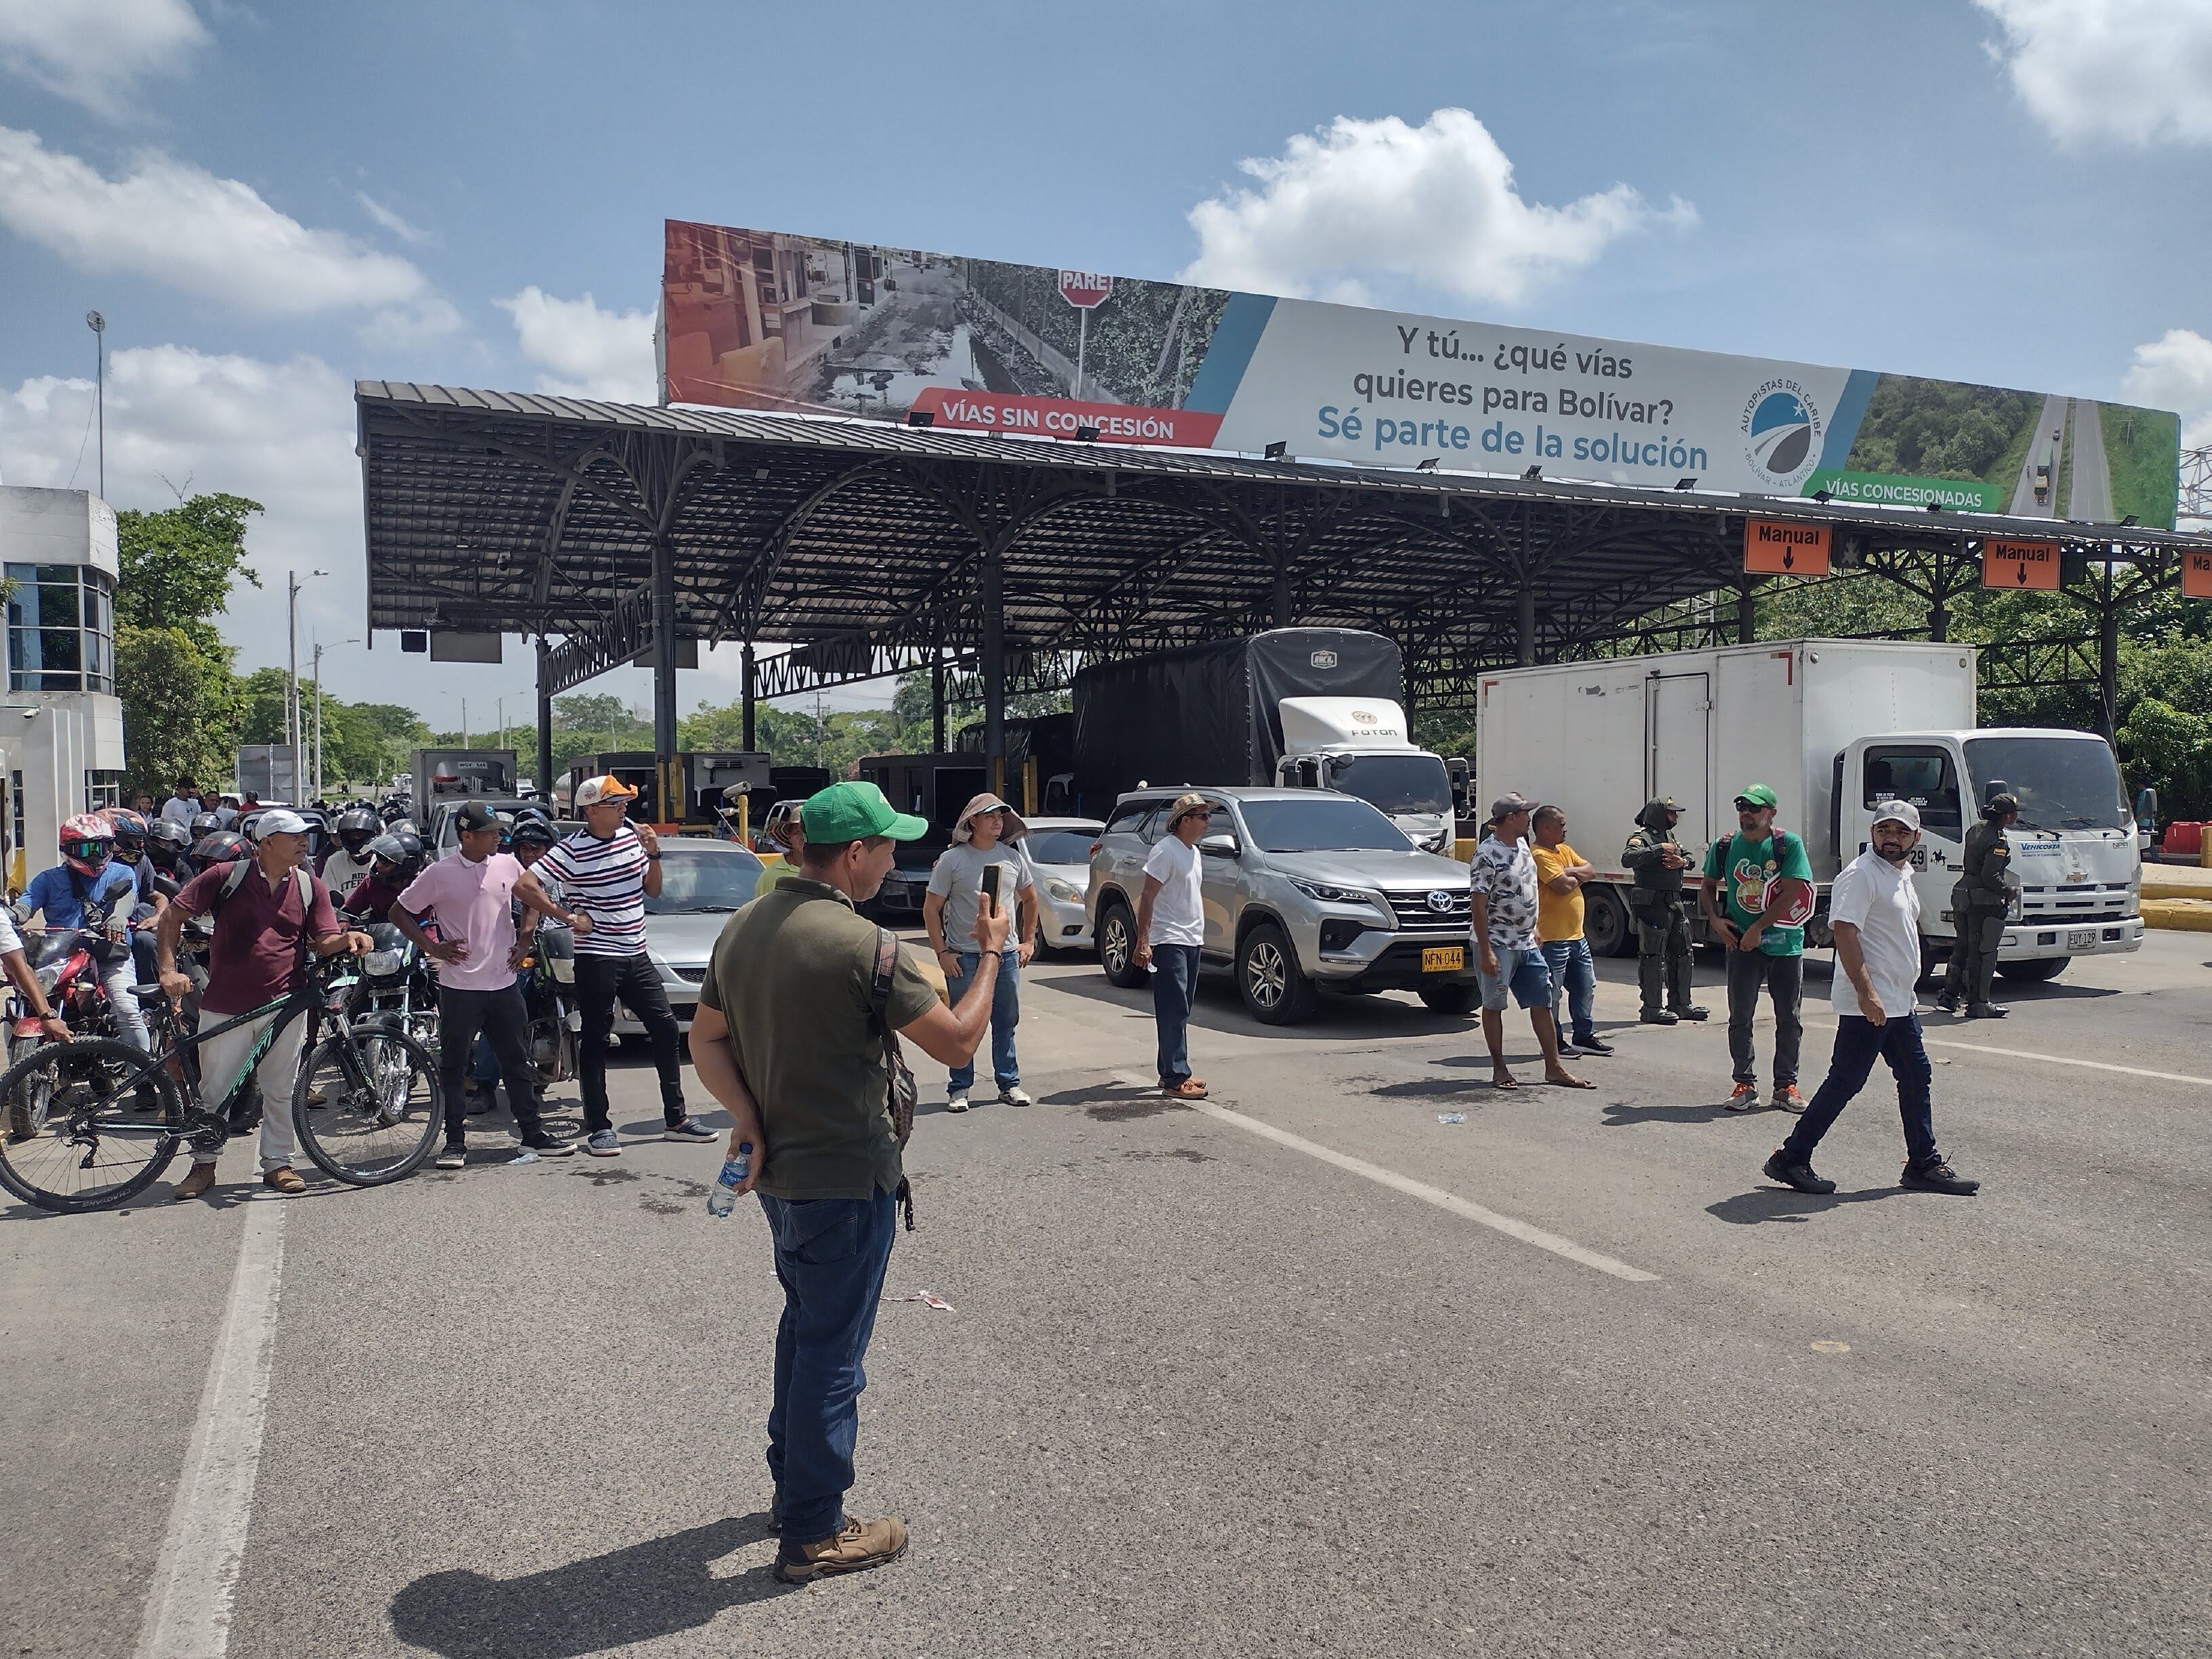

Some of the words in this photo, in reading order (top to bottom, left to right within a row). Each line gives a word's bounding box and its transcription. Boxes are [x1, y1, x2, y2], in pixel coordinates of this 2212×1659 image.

[1063, 272, 1107, 291] PARE
[1397, 325, 1419, 354] Y
[1427, 331, 1484, 362] tú...
[1494, 343, 1567, 374] ¿qué
[1575, 348, 1633, 379] vías
[1353, 369, 1473, 405] quieres
[1483, 386, 1548, 415] para
[1559, 388, 1674, 426] Bolívar?
[1741, 379, 1783, 432] AUTOPISTAS
[1786, 380, 1802, 396] DEL
[1803, 394, 1821, 437] CARIBE
[943, 399, 996, 424] VÍAS
[1002, 408, 1038, 428] SIN
[1046, 412, 1174, 439] CONCESIÓN
[1318, 406, 1362, 441] Sé
[1375, 417, 1471, 451] parte
[1481, 422, 1525, 455] de
[1536, 425, 1562, 458] la
[1574, 432, 1707, 471] solución
[1745, 453, 1771, 485] BOLÍVAR
[1779, 459, 1814, 487] ATLÁNTICO
[1826, 478, 1859, 497] VÍAS
[1863, 484, 1982, 508] CONCESIONADAS
[1759, 525, 1819, 545] Manual
[1996, 544, 2049, 562] Manual
[2193, 556, 2212, 571] Ma
